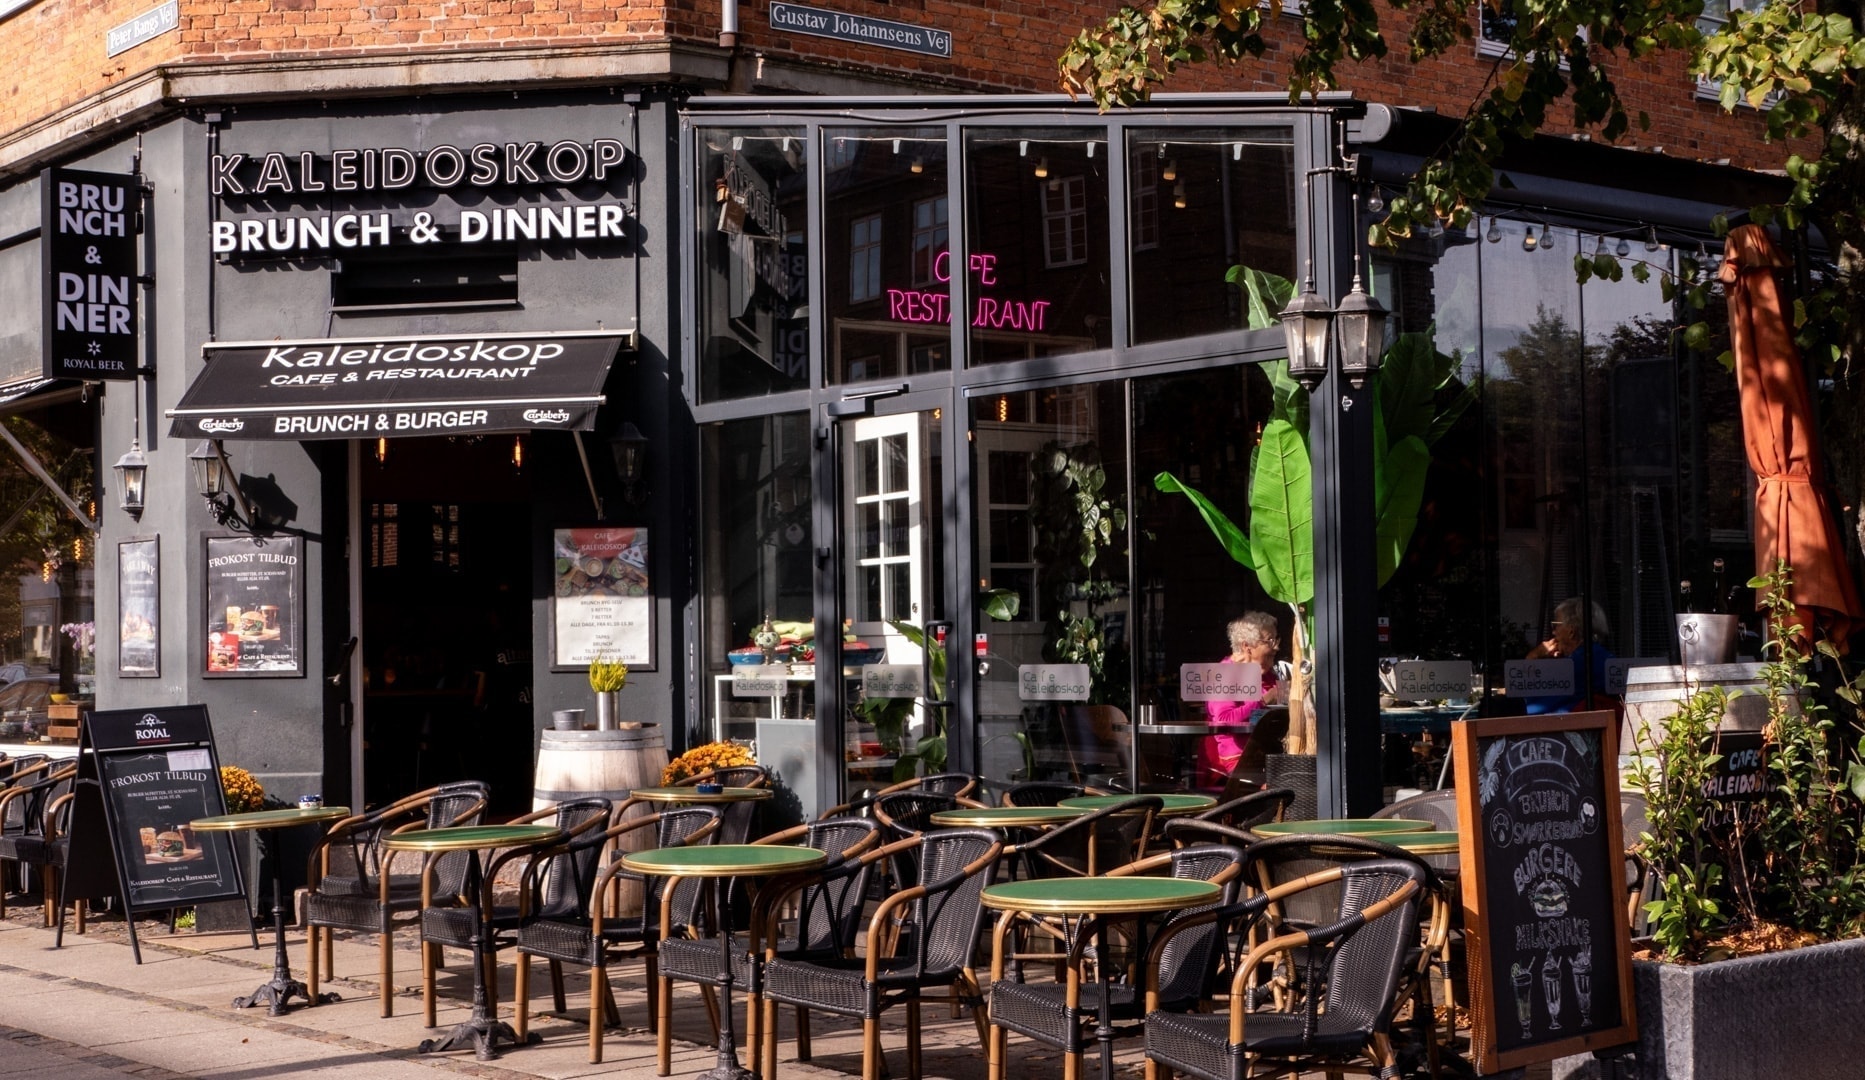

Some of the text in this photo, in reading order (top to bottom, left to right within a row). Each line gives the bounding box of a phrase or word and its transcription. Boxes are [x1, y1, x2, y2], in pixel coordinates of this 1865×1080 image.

[110, 6, 173, 49] Peter Bangs Vej
[773, 5, 949, 55] Gustav Johannsens Vej
[211, 138, 627, 195] KALEIDOSKOP
[59, 182, 124, 213] BRU
[59, 208, 126, 237] NCH
[212, 205, 626, 253] BRUNCH & DINNER
[84, 245, 102, 264] &
[935, 251, 996, 285] CFE
[58, 272, 129, 305] DIN
[57, 301, 132, 335] NER
[63, 358, 125, 371] ROYAL BEER
[260, 338, 566, 371] Kaleidoskop
[270, 367, 536, 385] CAFE & RESTAURANT
[198, 416, 245, 433] Carlsberg
[274, 410, 488, 434] BRUNCH & BURGER
[523, 408, 570, 424] Carlsberg
[581, 543, 627, 551] KALEIDOSKOP
[208, 553, 297, 568] FROKOST TILBUD
[735, 681, 785, 692] Kaleidoskop
[1023, 682, 1085, 696] Kaleidoskop
[1185, 682, 1257, 696] Kaleidoskop
[1401, 681, 1467, 695] Kaleidoskop
[1509, 678, 1571, 691] Kaleidoskop
[135, 727, 171, 740] ROYAL
[1520, 741, 1552, 762] CAFE
[1728, 748, 1758, 771] CAFE
[110, 771, 207, 788] FROKOST TILBUD
[1519, 789, 1570, 815] BRUNCH
[1514, 843, 1582, 896] BURGERE
